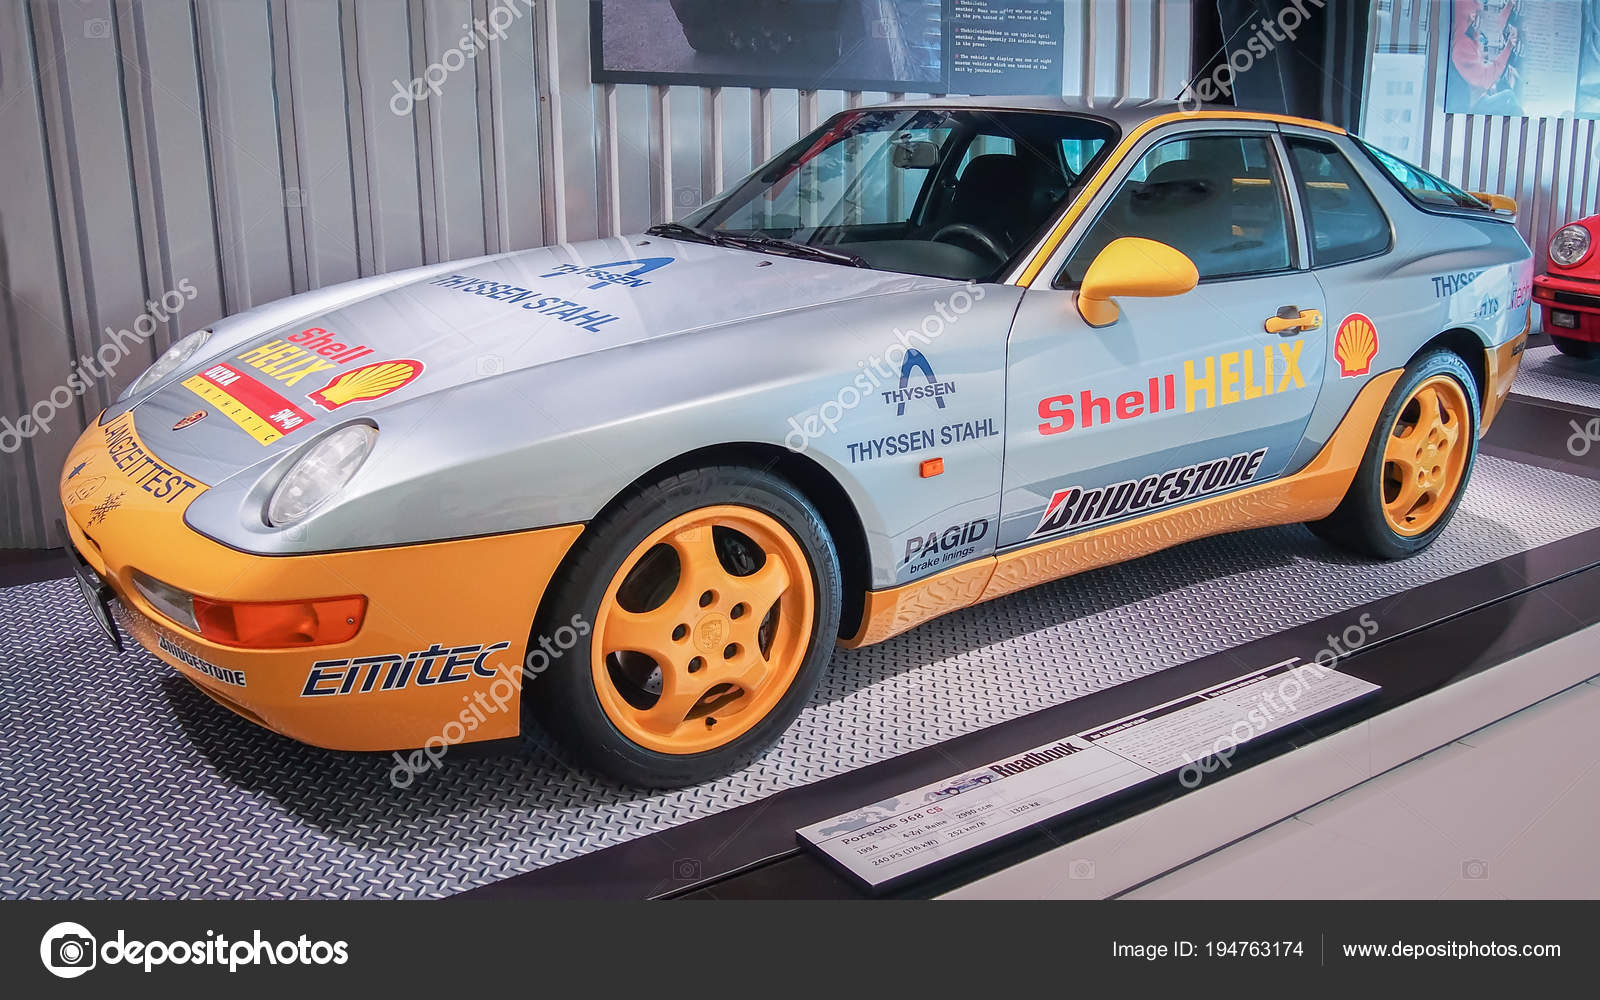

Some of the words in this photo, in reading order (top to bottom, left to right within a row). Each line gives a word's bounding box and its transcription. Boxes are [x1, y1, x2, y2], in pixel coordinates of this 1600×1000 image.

[552, 263, 652, 288] THYSSEN
[429, 275, 541, 304] THYSSEN
[522, 297, 620, 333] STAHL
[236, 339, 336, 388] HELIX
[287, 327, 375, 364] Shell
[204, 365, 241, 387] ULTRA
[881, 381, 956, 405] THYSSEN
[1037, 373, 1175, 436] Shell
[1183, 339, 1306, 414] HELIX
[104, 415, 197, 504] LANGZEITTEST
[847, 428, 935, 464] THYSSEN
[940, 418, 1000, 445] STAHL
[1031, 448, 1268, 536] BRIDGESTONE
[903, 519, 989, 564] PAGID
[910, 557, 940, 574] brake
[942, 546, 975, 563] linings
[158, 636, 247, 687] BRIDGESTONE
[988, 742, 1085, 778] Roadbook
[841, 822, 898, 845] Porsche
[900, 812, 924, 825] 968
[926, 806, 944, 815] CS
[872, 857, 890, 866] 240
